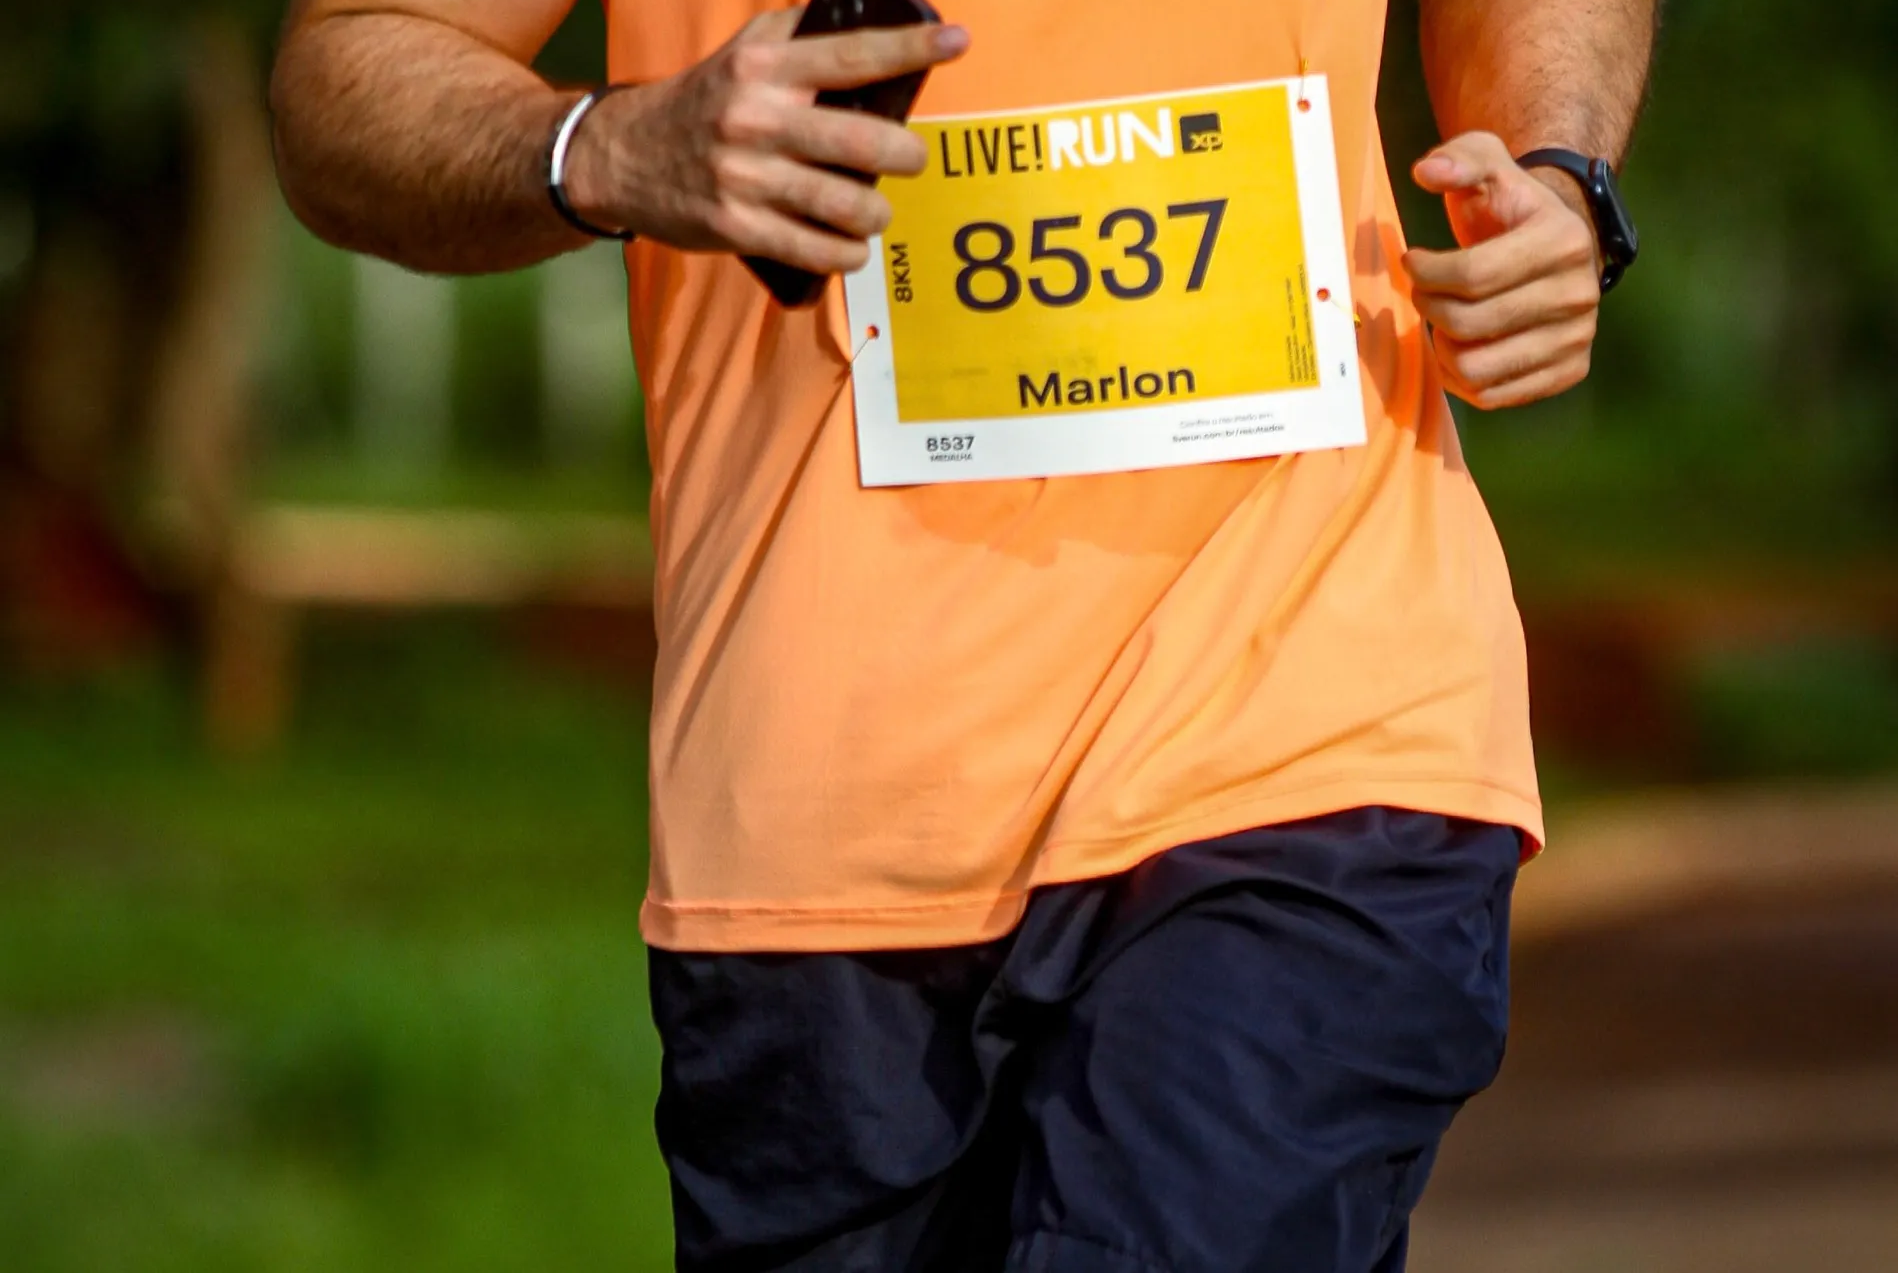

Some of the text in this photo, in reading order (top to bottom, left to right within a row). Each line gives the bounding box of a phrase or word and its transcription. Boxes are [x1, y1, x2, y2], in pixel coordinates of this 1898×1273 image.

[889, 242, 912, 302] 8KM
[953, 197, 1230, 313] 8537
[1018, 366, 1197, 409] Marlon
[926, 435, 976, 453] 8537
